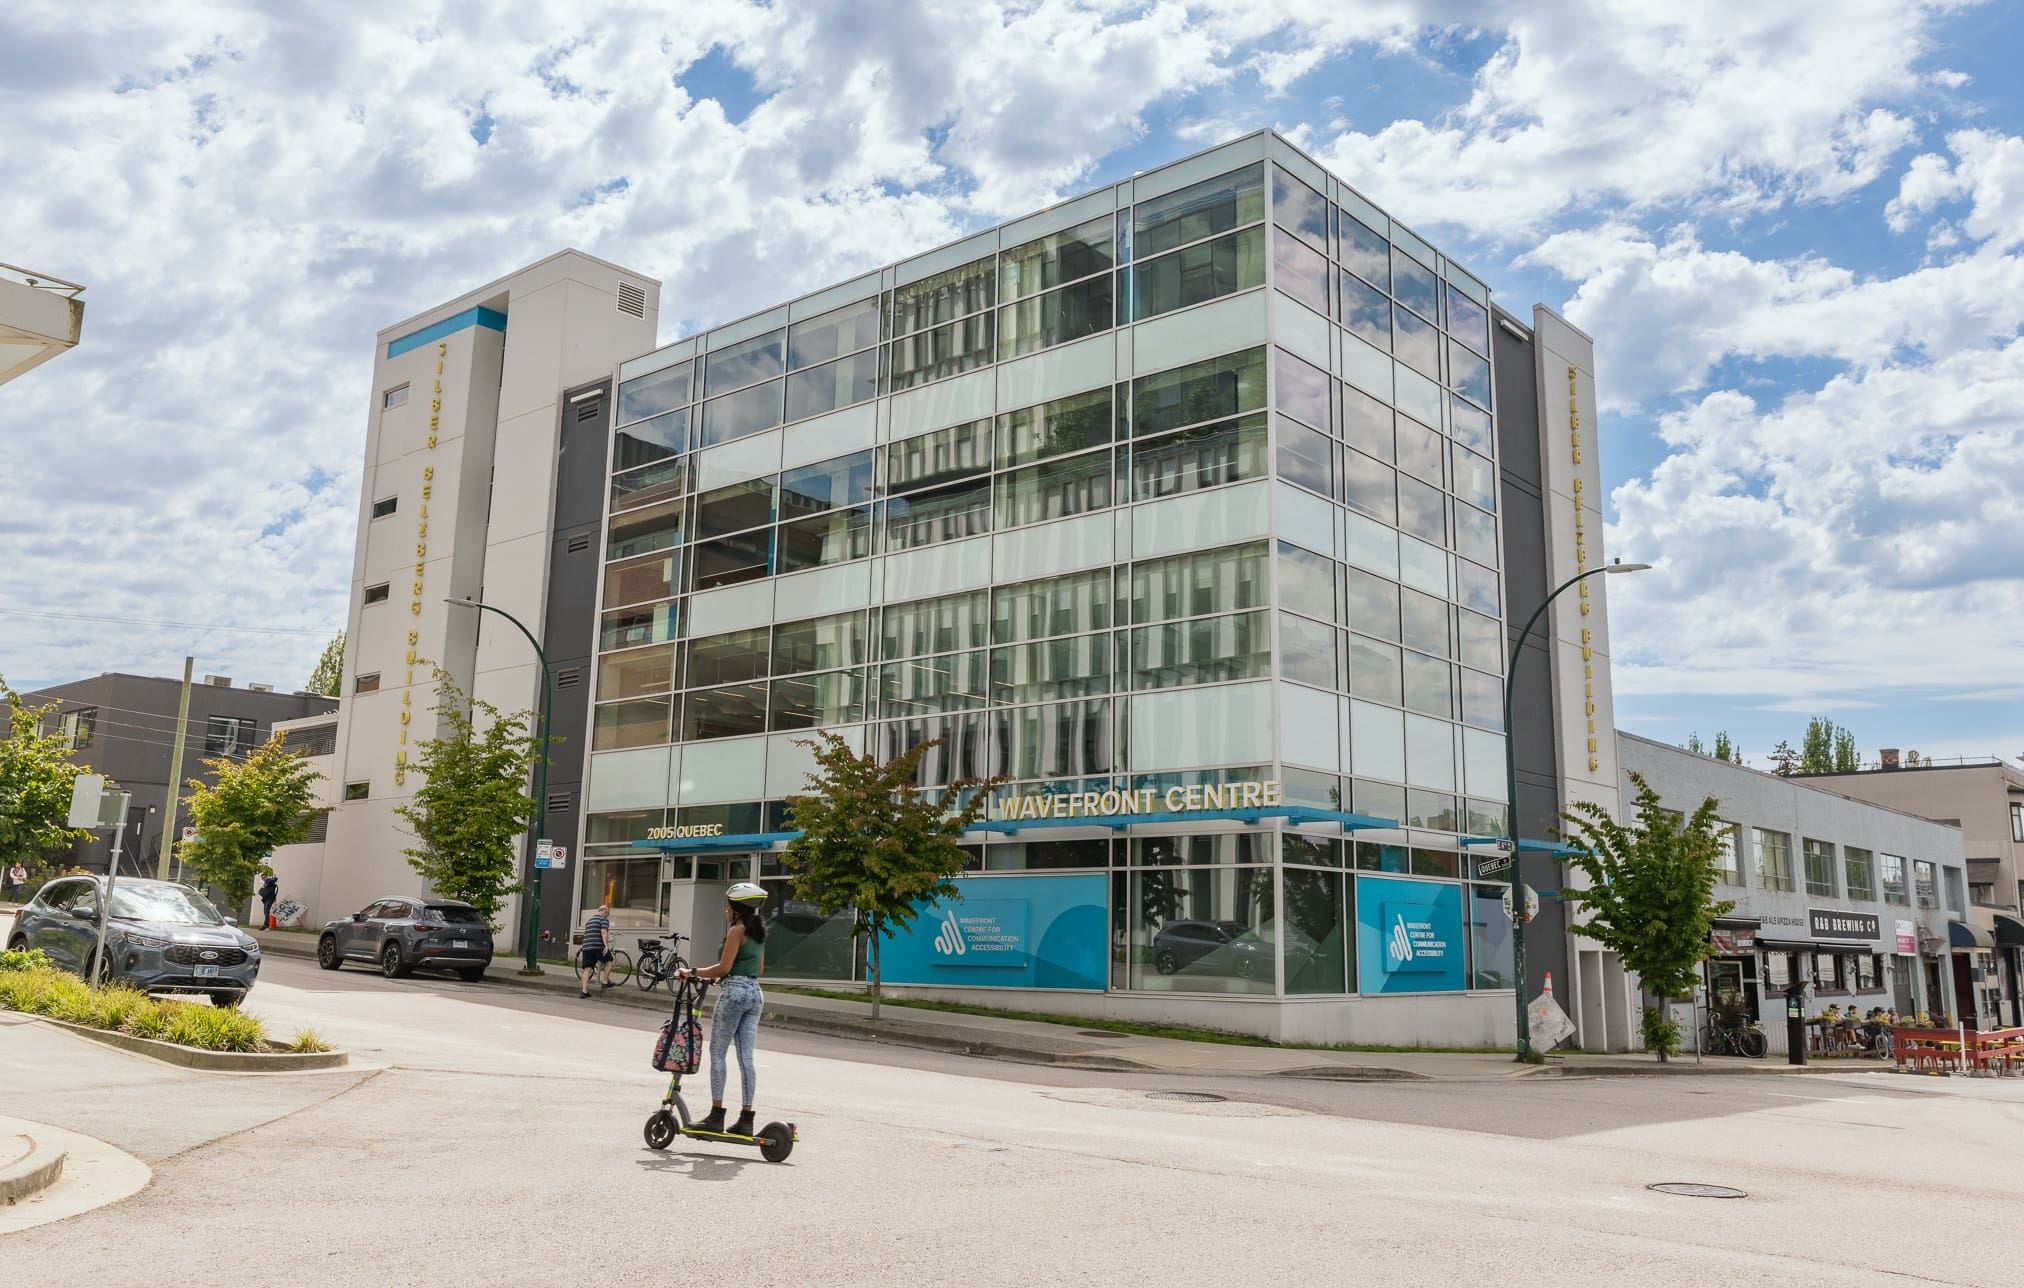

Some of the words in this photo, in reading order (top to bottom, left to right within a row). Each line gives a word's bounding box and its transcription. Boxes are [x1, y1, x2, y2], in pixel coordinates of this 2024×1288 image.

[427, 343, 447, 449] SILBER
[1568, 364, 1582, 465] SILBER
[1582, 628, 1599, 772] BUILDING
[394, 629, 418, 786] BUILDING
[998, 788, 1157, 820] WAVEFRONT
[1165, 780, 1280, 813] CENTRE
[647, 826, 674, 840] 2005
[676, 823, 723, 838] QUEBEC
[1481, 861, 1501, 873] QUEBEC
[1814, 916, 1829, 931] R&B
[1832, 918, 1864, 932] BREWING
